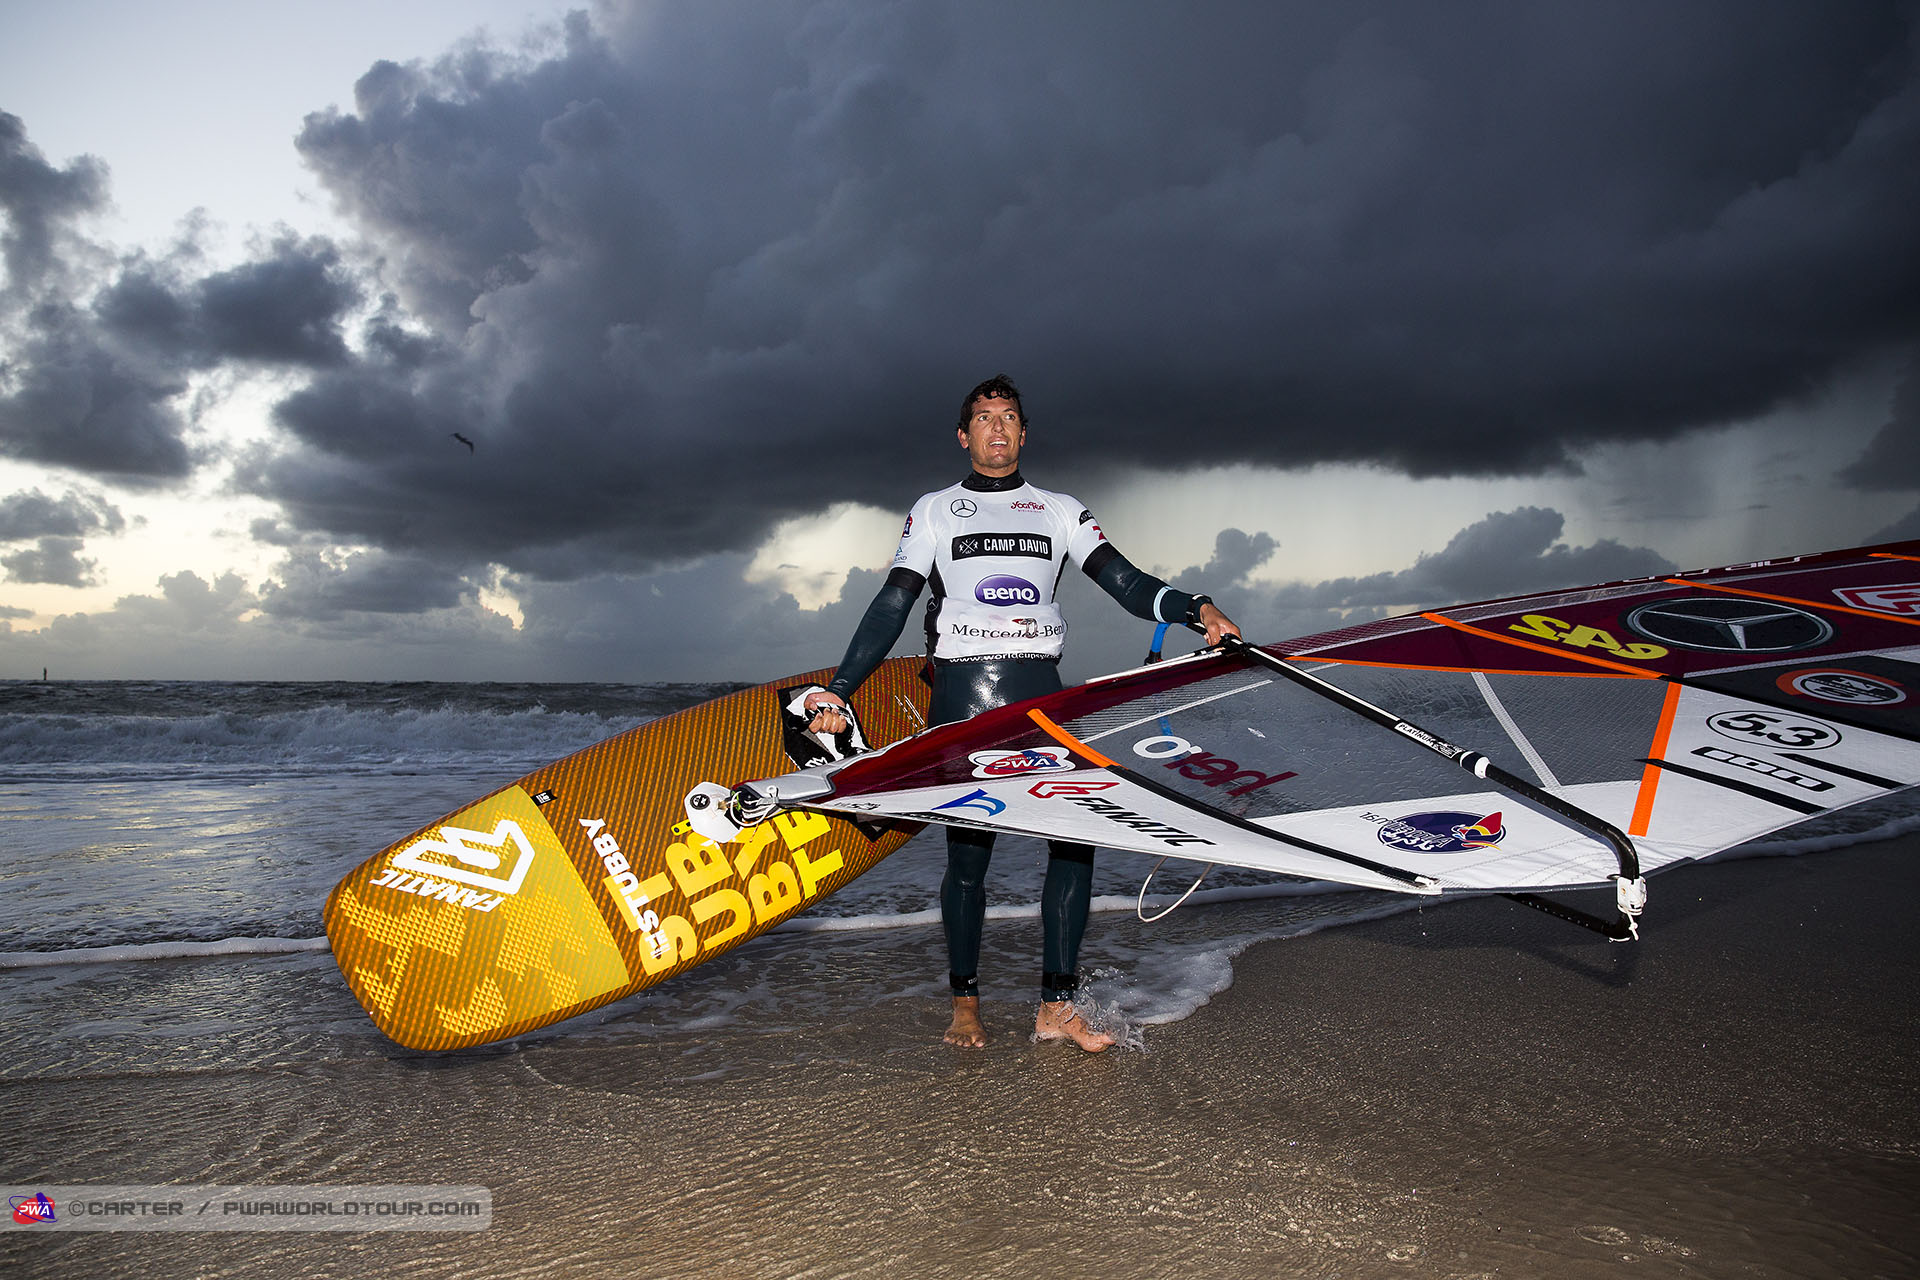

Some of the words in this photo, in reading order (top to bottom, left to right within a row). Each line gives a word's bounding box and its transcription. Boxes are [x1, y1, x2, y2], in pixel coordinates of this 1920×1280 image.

[983, 538, 1015, 552] CAMP
[1018, 538, 1049, 555] DAVID
[982, 587, 1036, 602] BenQ
[951, 623, 1065, 639] Merceds-Ben
[1716, 713, 1830, 747] 5.3
[993, 758, 1051, 770] PWA
[1062, 797, 1218, 847] FANATIC
[578, 818, 660, 933] STUBBY
[368, 868, 506, 913] FANATIC
